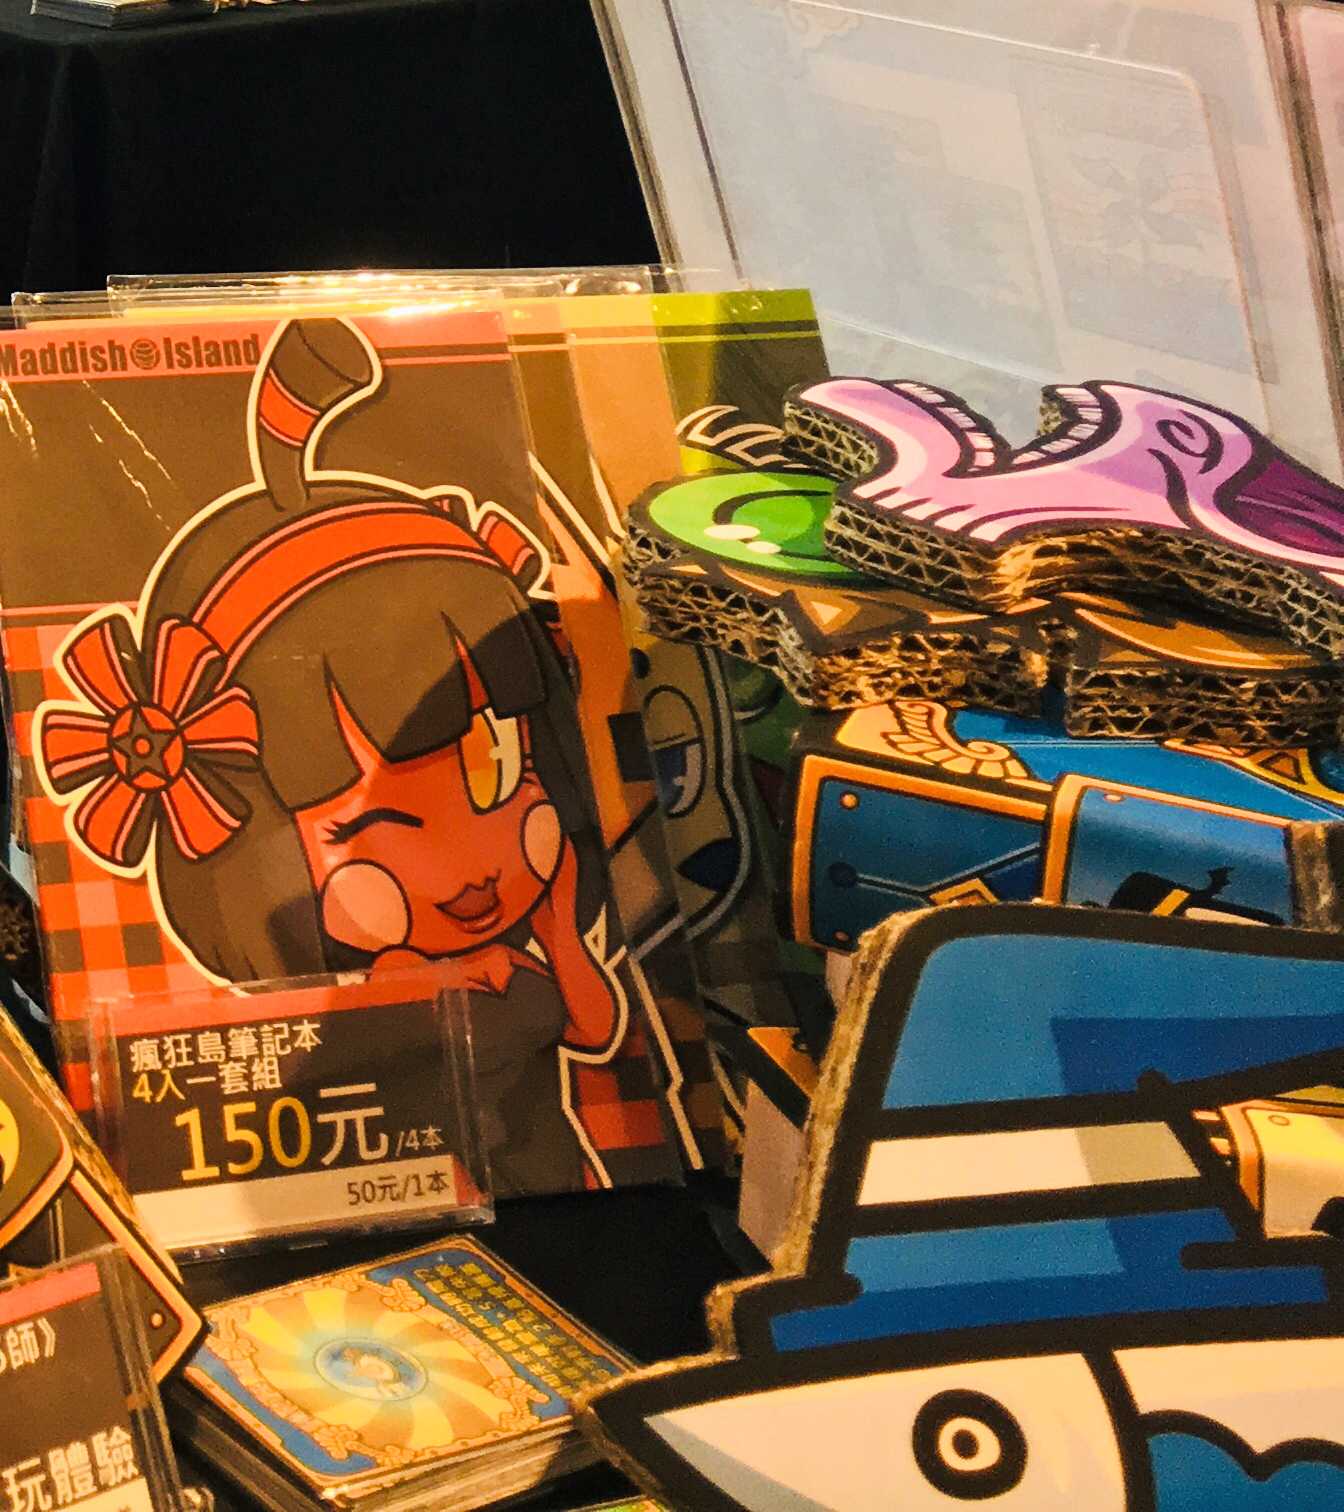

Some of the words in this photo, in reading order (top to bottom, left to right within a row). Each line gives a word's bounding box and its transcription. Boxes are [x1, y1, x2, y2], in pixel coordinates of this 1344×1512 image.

[163, 333, 262, 371] Island
[128, 1019, 323, 1073] 瘋狂島筆記本
[175, 1083, 391, 1182] 150元
[346, 1169, 452, 1207] 50元/1本
